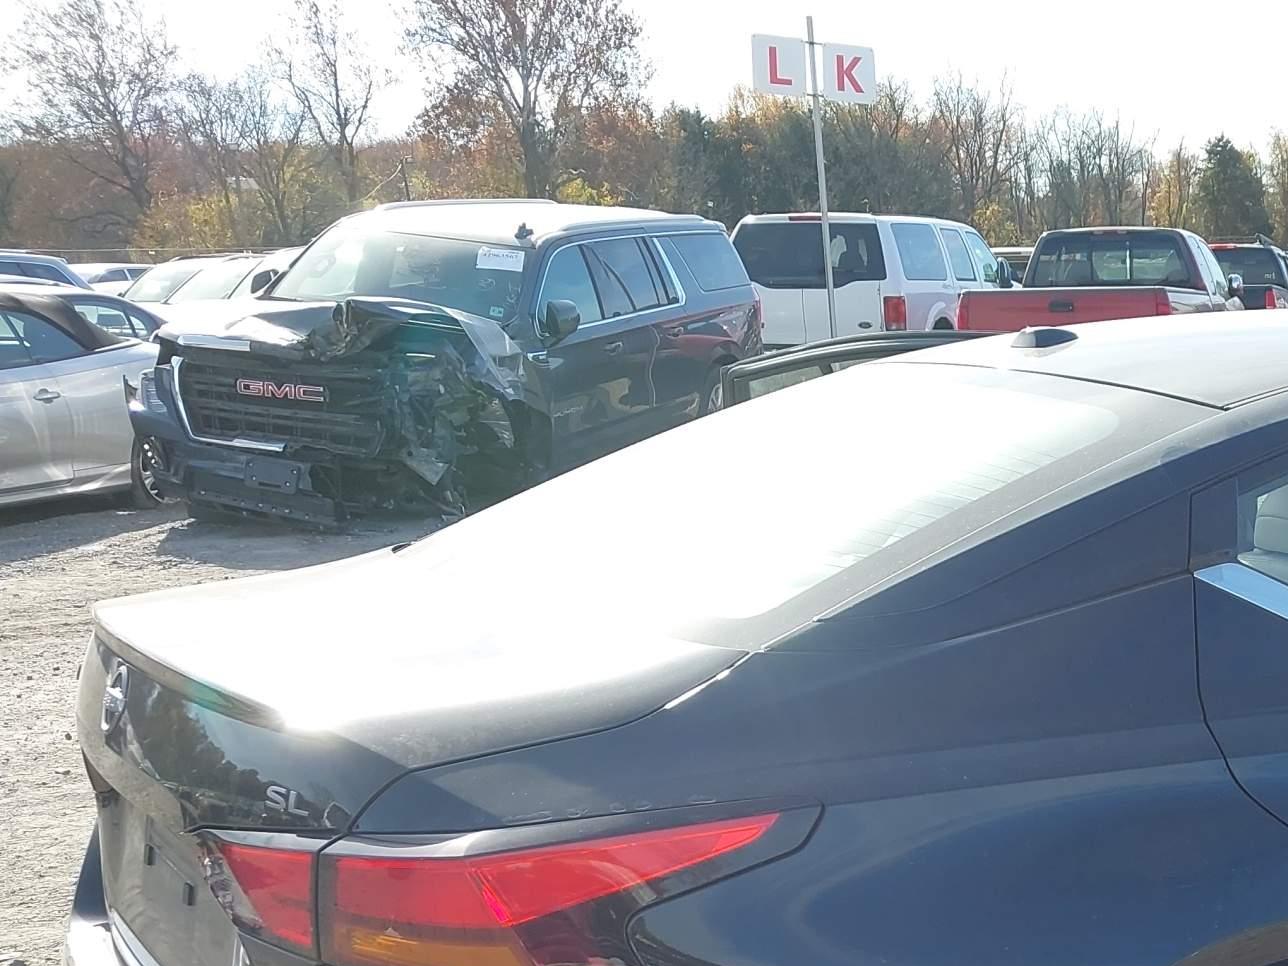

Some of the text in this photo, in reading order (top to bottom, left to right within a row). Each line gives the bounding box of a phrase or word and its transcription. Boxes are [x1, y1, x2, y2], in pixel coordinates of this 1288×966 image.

[768, 46, 793, 86] L
[836, 54, 865, 94] K
[236, 378, 324, 402] GMC
[264, 785, 309, 817] SL
